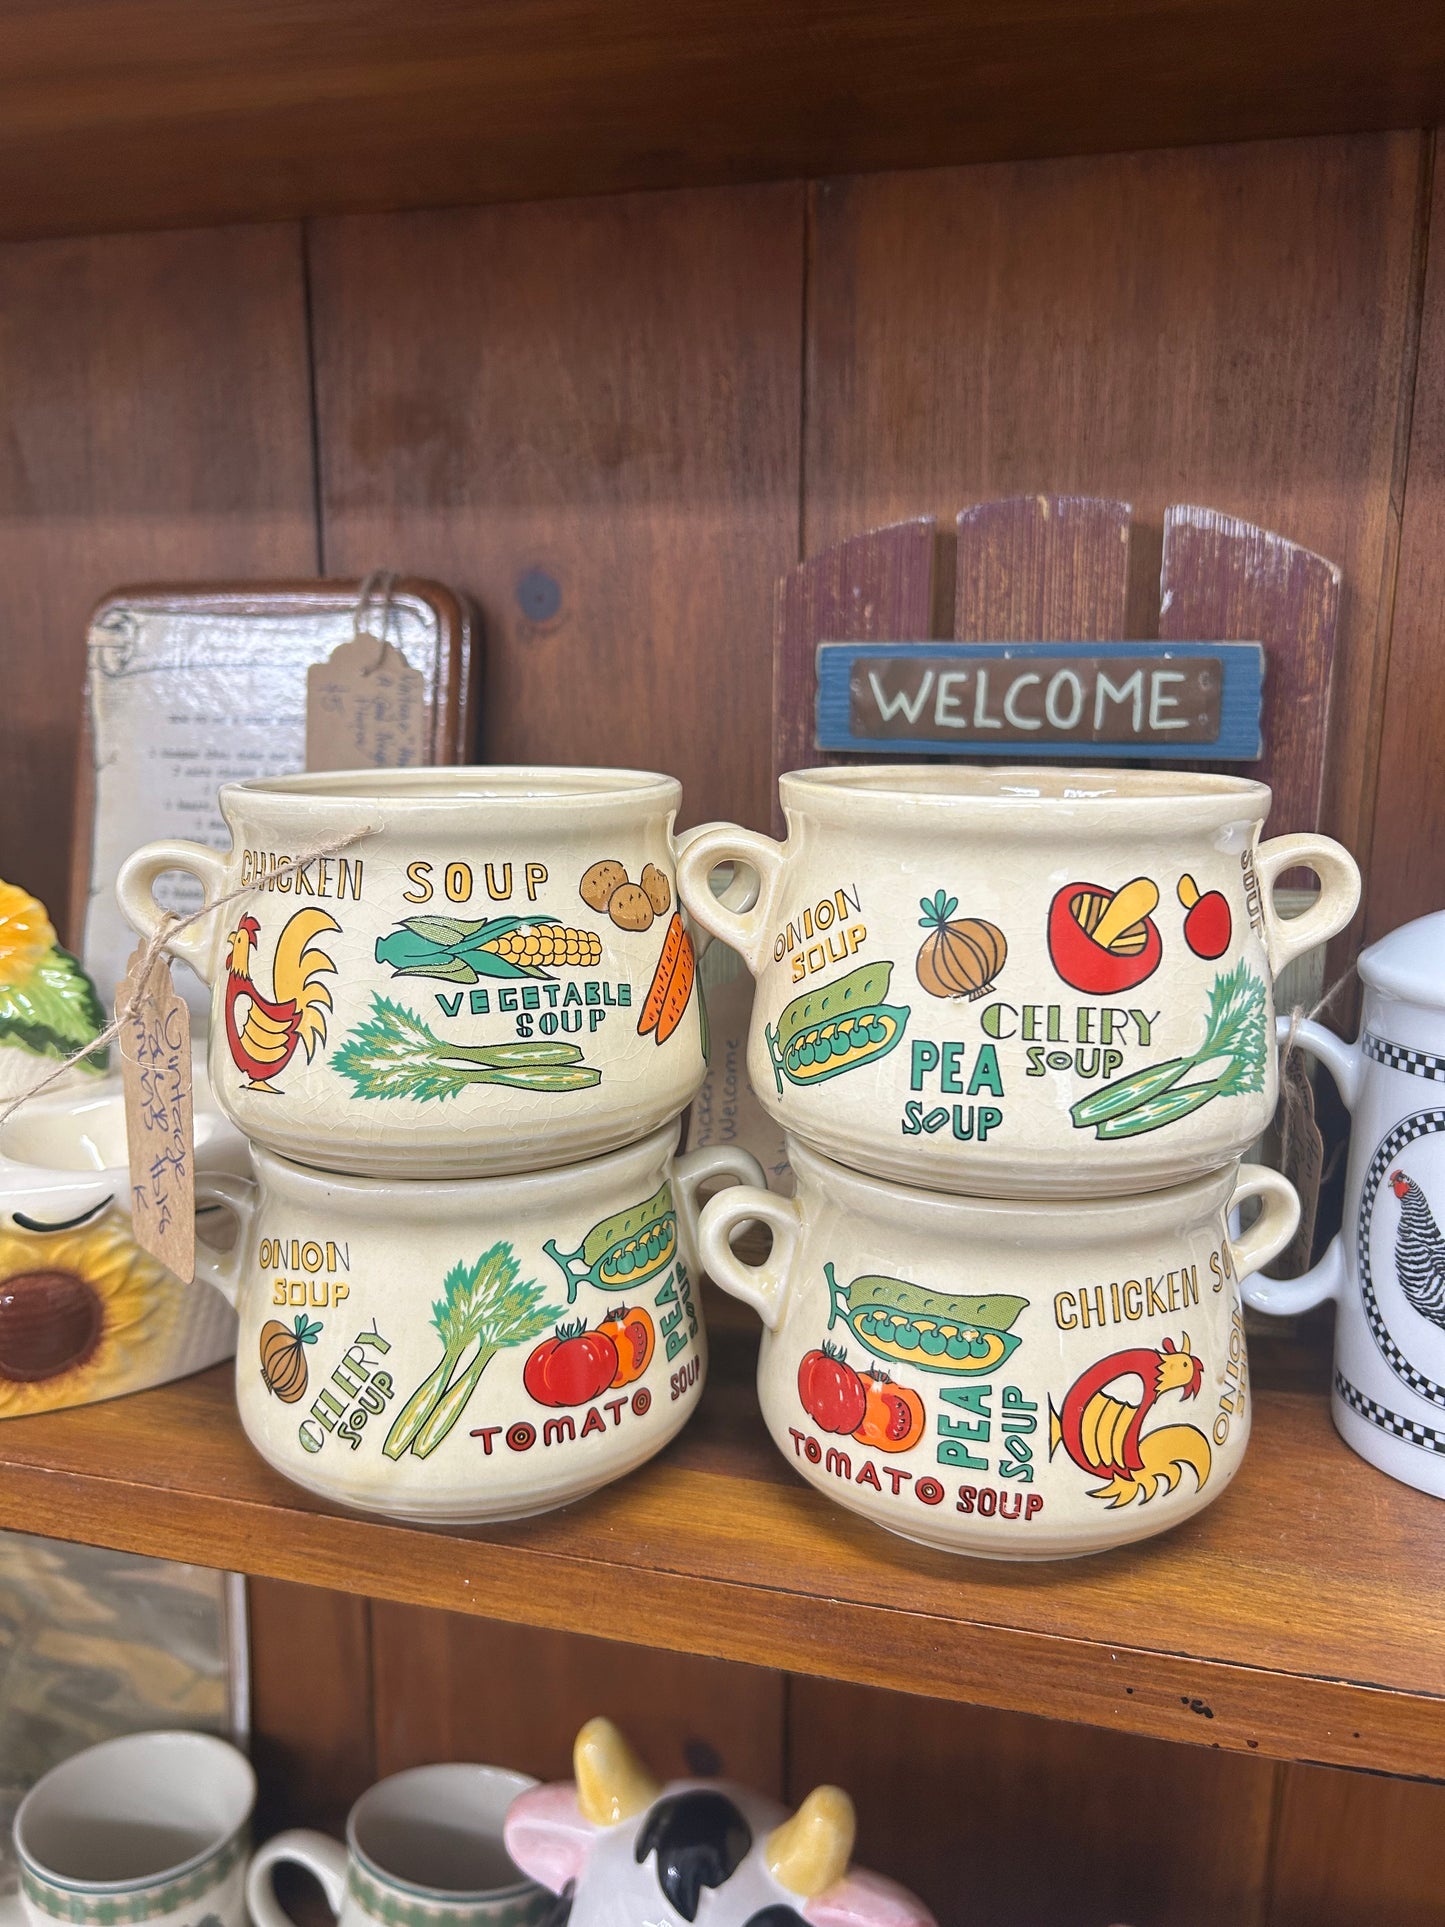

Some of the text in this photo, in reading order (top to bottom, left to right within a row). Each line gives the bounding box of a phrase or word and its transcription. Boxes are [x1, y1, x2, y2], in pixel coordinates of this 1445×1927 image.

[868, 668, 1191, 733] WELCOME
[242, 849, 548, 902] CHICKEN SOUP
[1241, 850, 1263, 940] SOUP
[773, 883, 862, 963] ONION
[791, 924, 867, 983] SOUP
[435, 982, 632, 1018] VEGETABLE
[516, 1009, 606, 1037] SOUP
[980, 1002, 1161, 1047] CELERY
[165, 1007, 187, 1190] Vintage
[719, 1038, 740, 1143] Welcome
[910, 1040, 1004, 1098] PEA
[1026, 1047, 1124, 1079] SOUP
[902, 1101, 1004, 1141] SOUP
[259, 1238, 350, 1272] ONION
[273, 1278, 350, 1309] SOUP
[1053, 1239, 1231, 1332] CHICKEN SO
[655, 1271, 688, 1362] PEA
[676, 1261, 699, 1339] SOUP
[299, 1317, 392, 1453] CELERY
[338, 1371, 395, 1451] SOUP
[470, 1354, 701, 1456] TOMATO SOUP
[1213, 1296, 1241, 1446] ONION
[936, 1384, 993, 1471] PEA
[999, 1385, 1039, 1484] SOUP
[789, 1427, 1043, 1521] TOMATO SOUP
